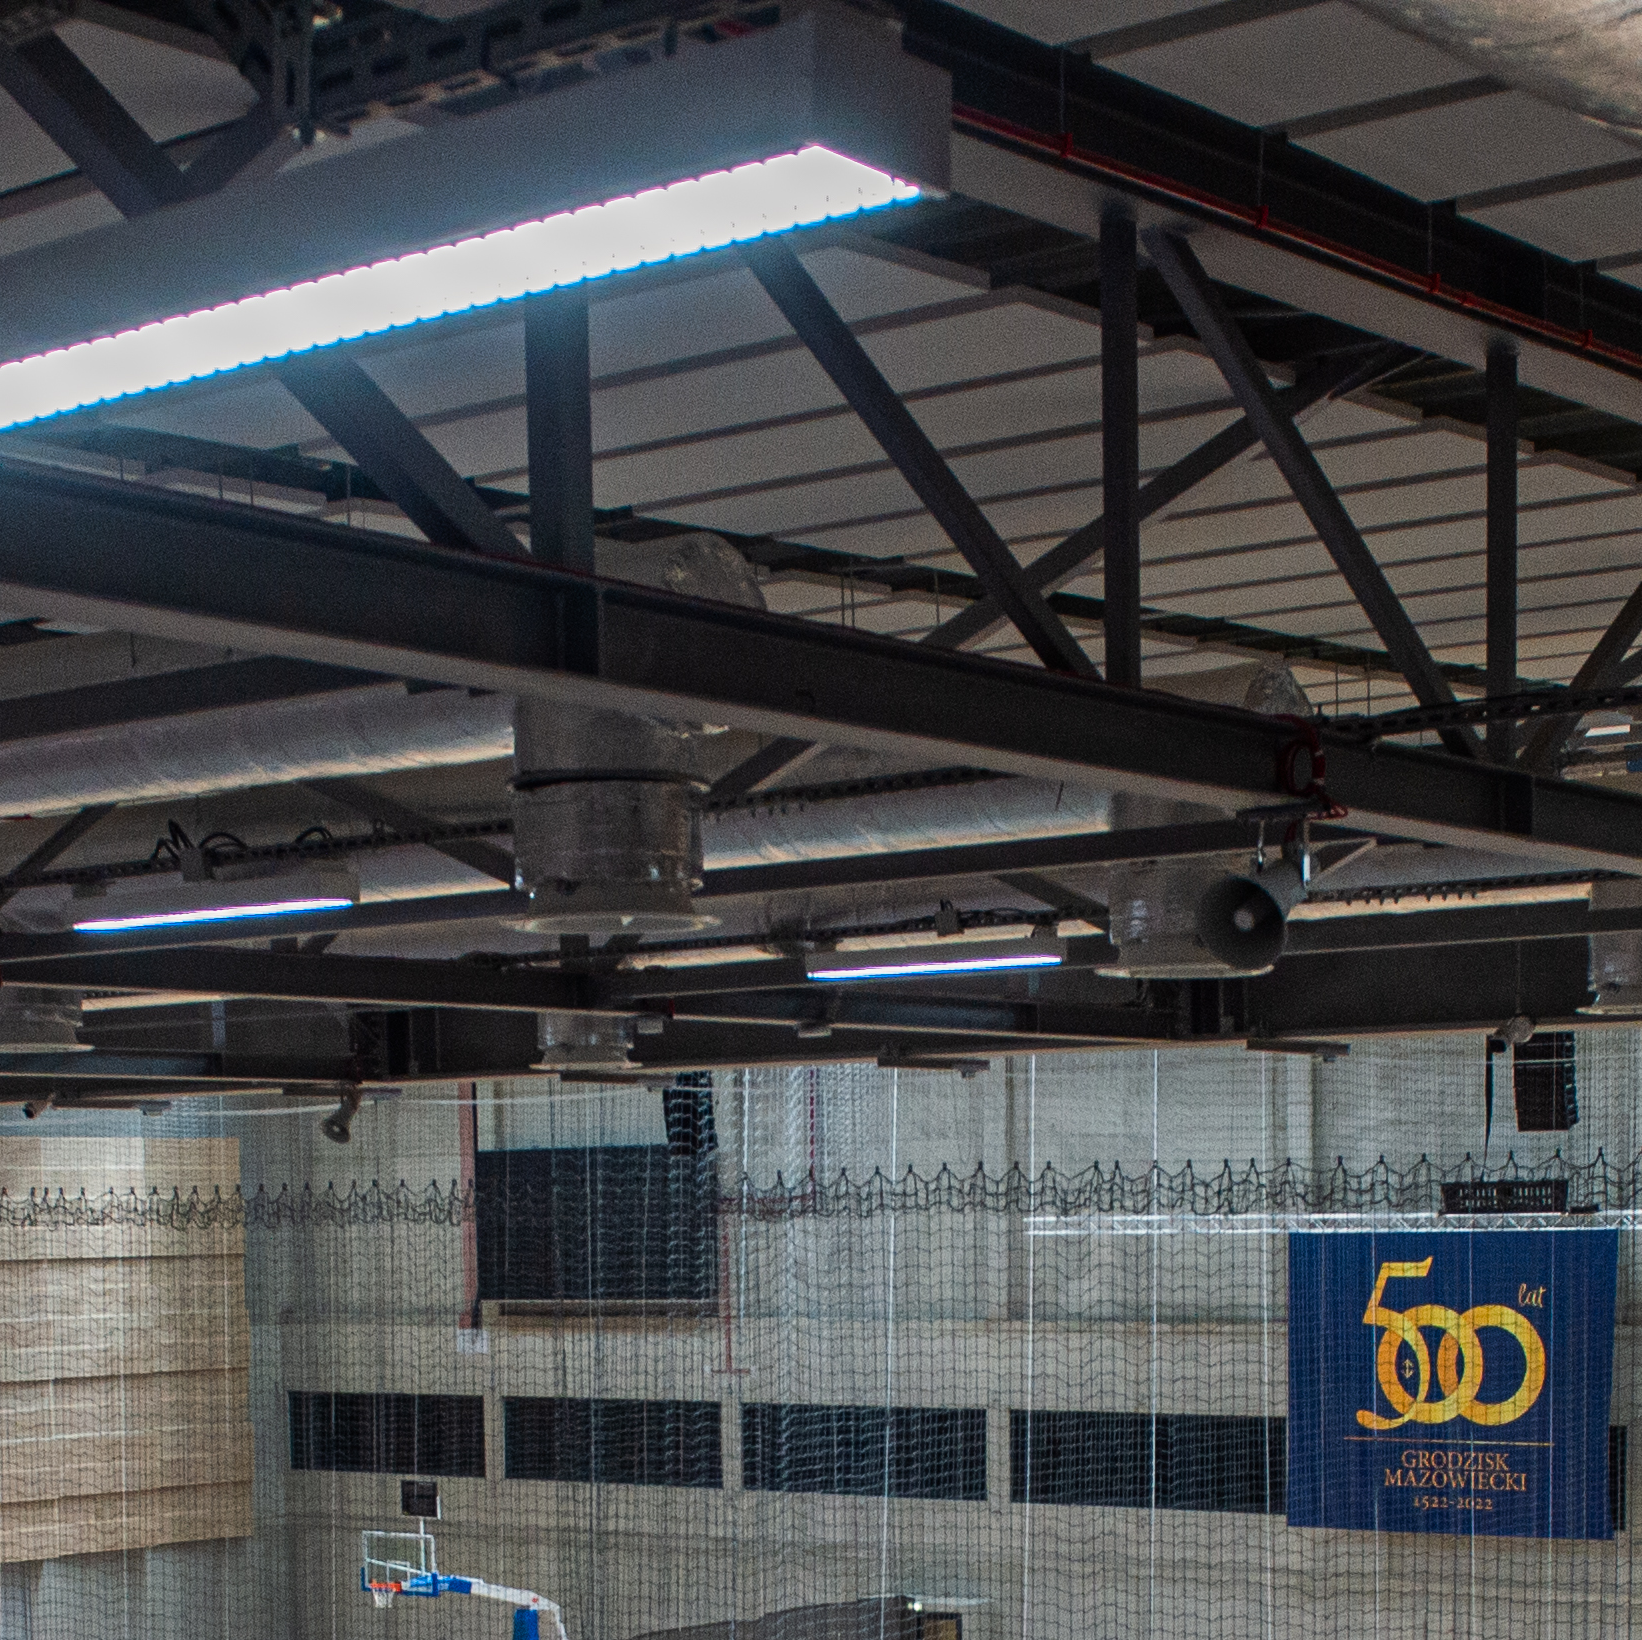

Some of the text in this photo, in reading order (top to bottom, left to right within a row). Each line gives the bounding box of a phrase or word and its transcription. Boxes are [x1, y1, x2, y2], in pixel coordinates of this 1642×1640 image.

[1356, 1255, 1547, 1430] 500 lat
[1401, 1450, 1509, 1471] GRODZISK
[1384, 1468, 1527, 1491] MAZOWIECKI
[1414, 1495, 1493, 1510] 1522-2022
